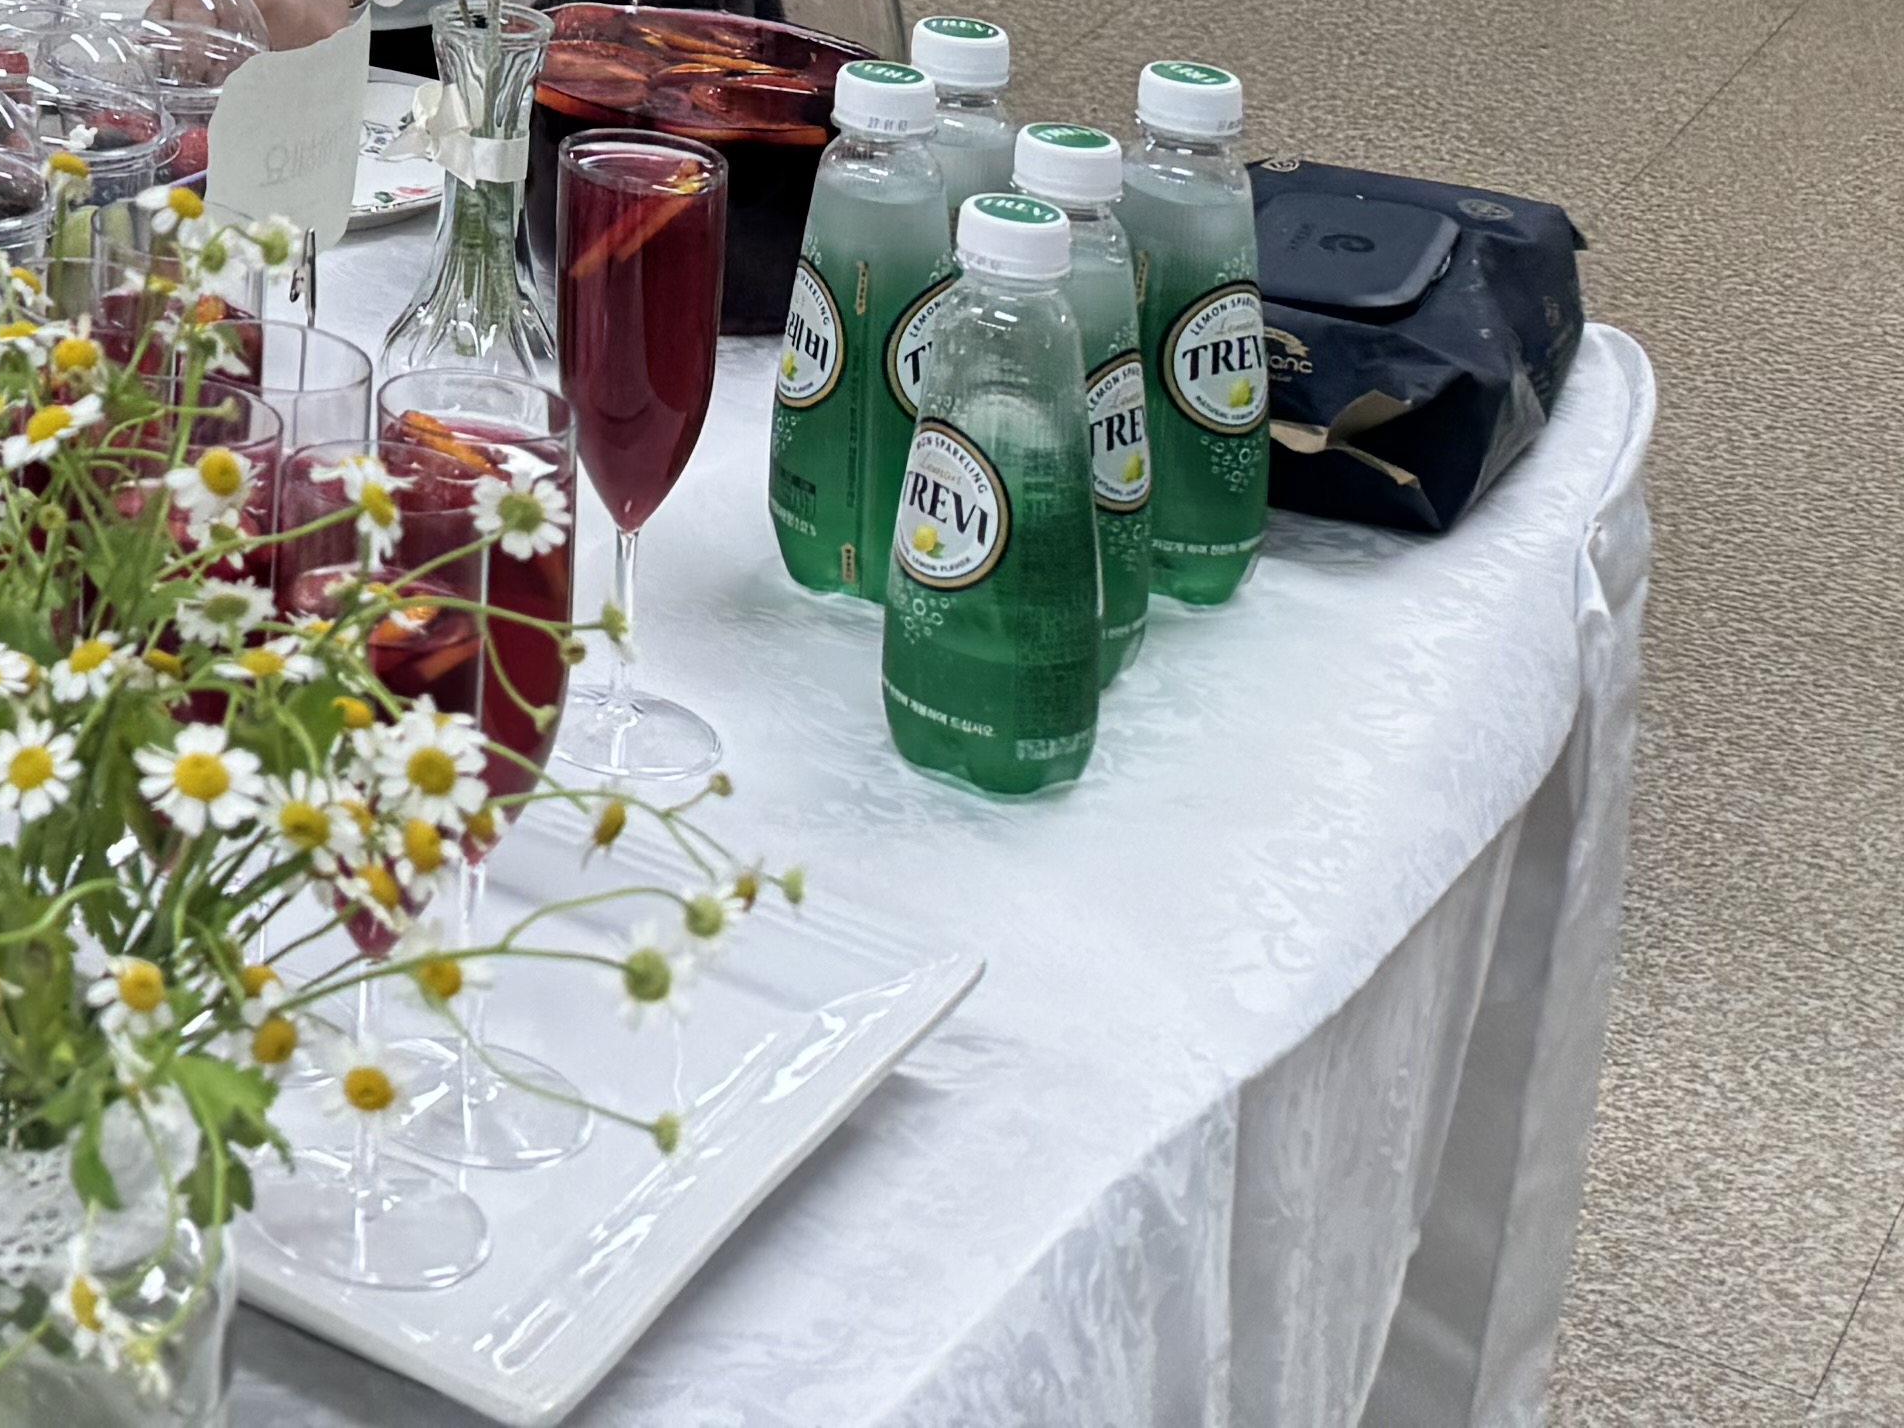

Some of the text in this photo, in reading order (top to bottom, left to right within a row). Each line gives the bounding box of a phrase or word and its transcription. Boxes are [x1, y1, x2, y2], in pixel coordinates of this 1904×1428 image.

[787, 311, 829, 373] 레비
[909, 300, 942, 338] LEMON
[1190, 302, 1228, 336] LEMON
[1090, 404, 1145, 459] TRE
[935, 437, 989, 495] SPARKLING
